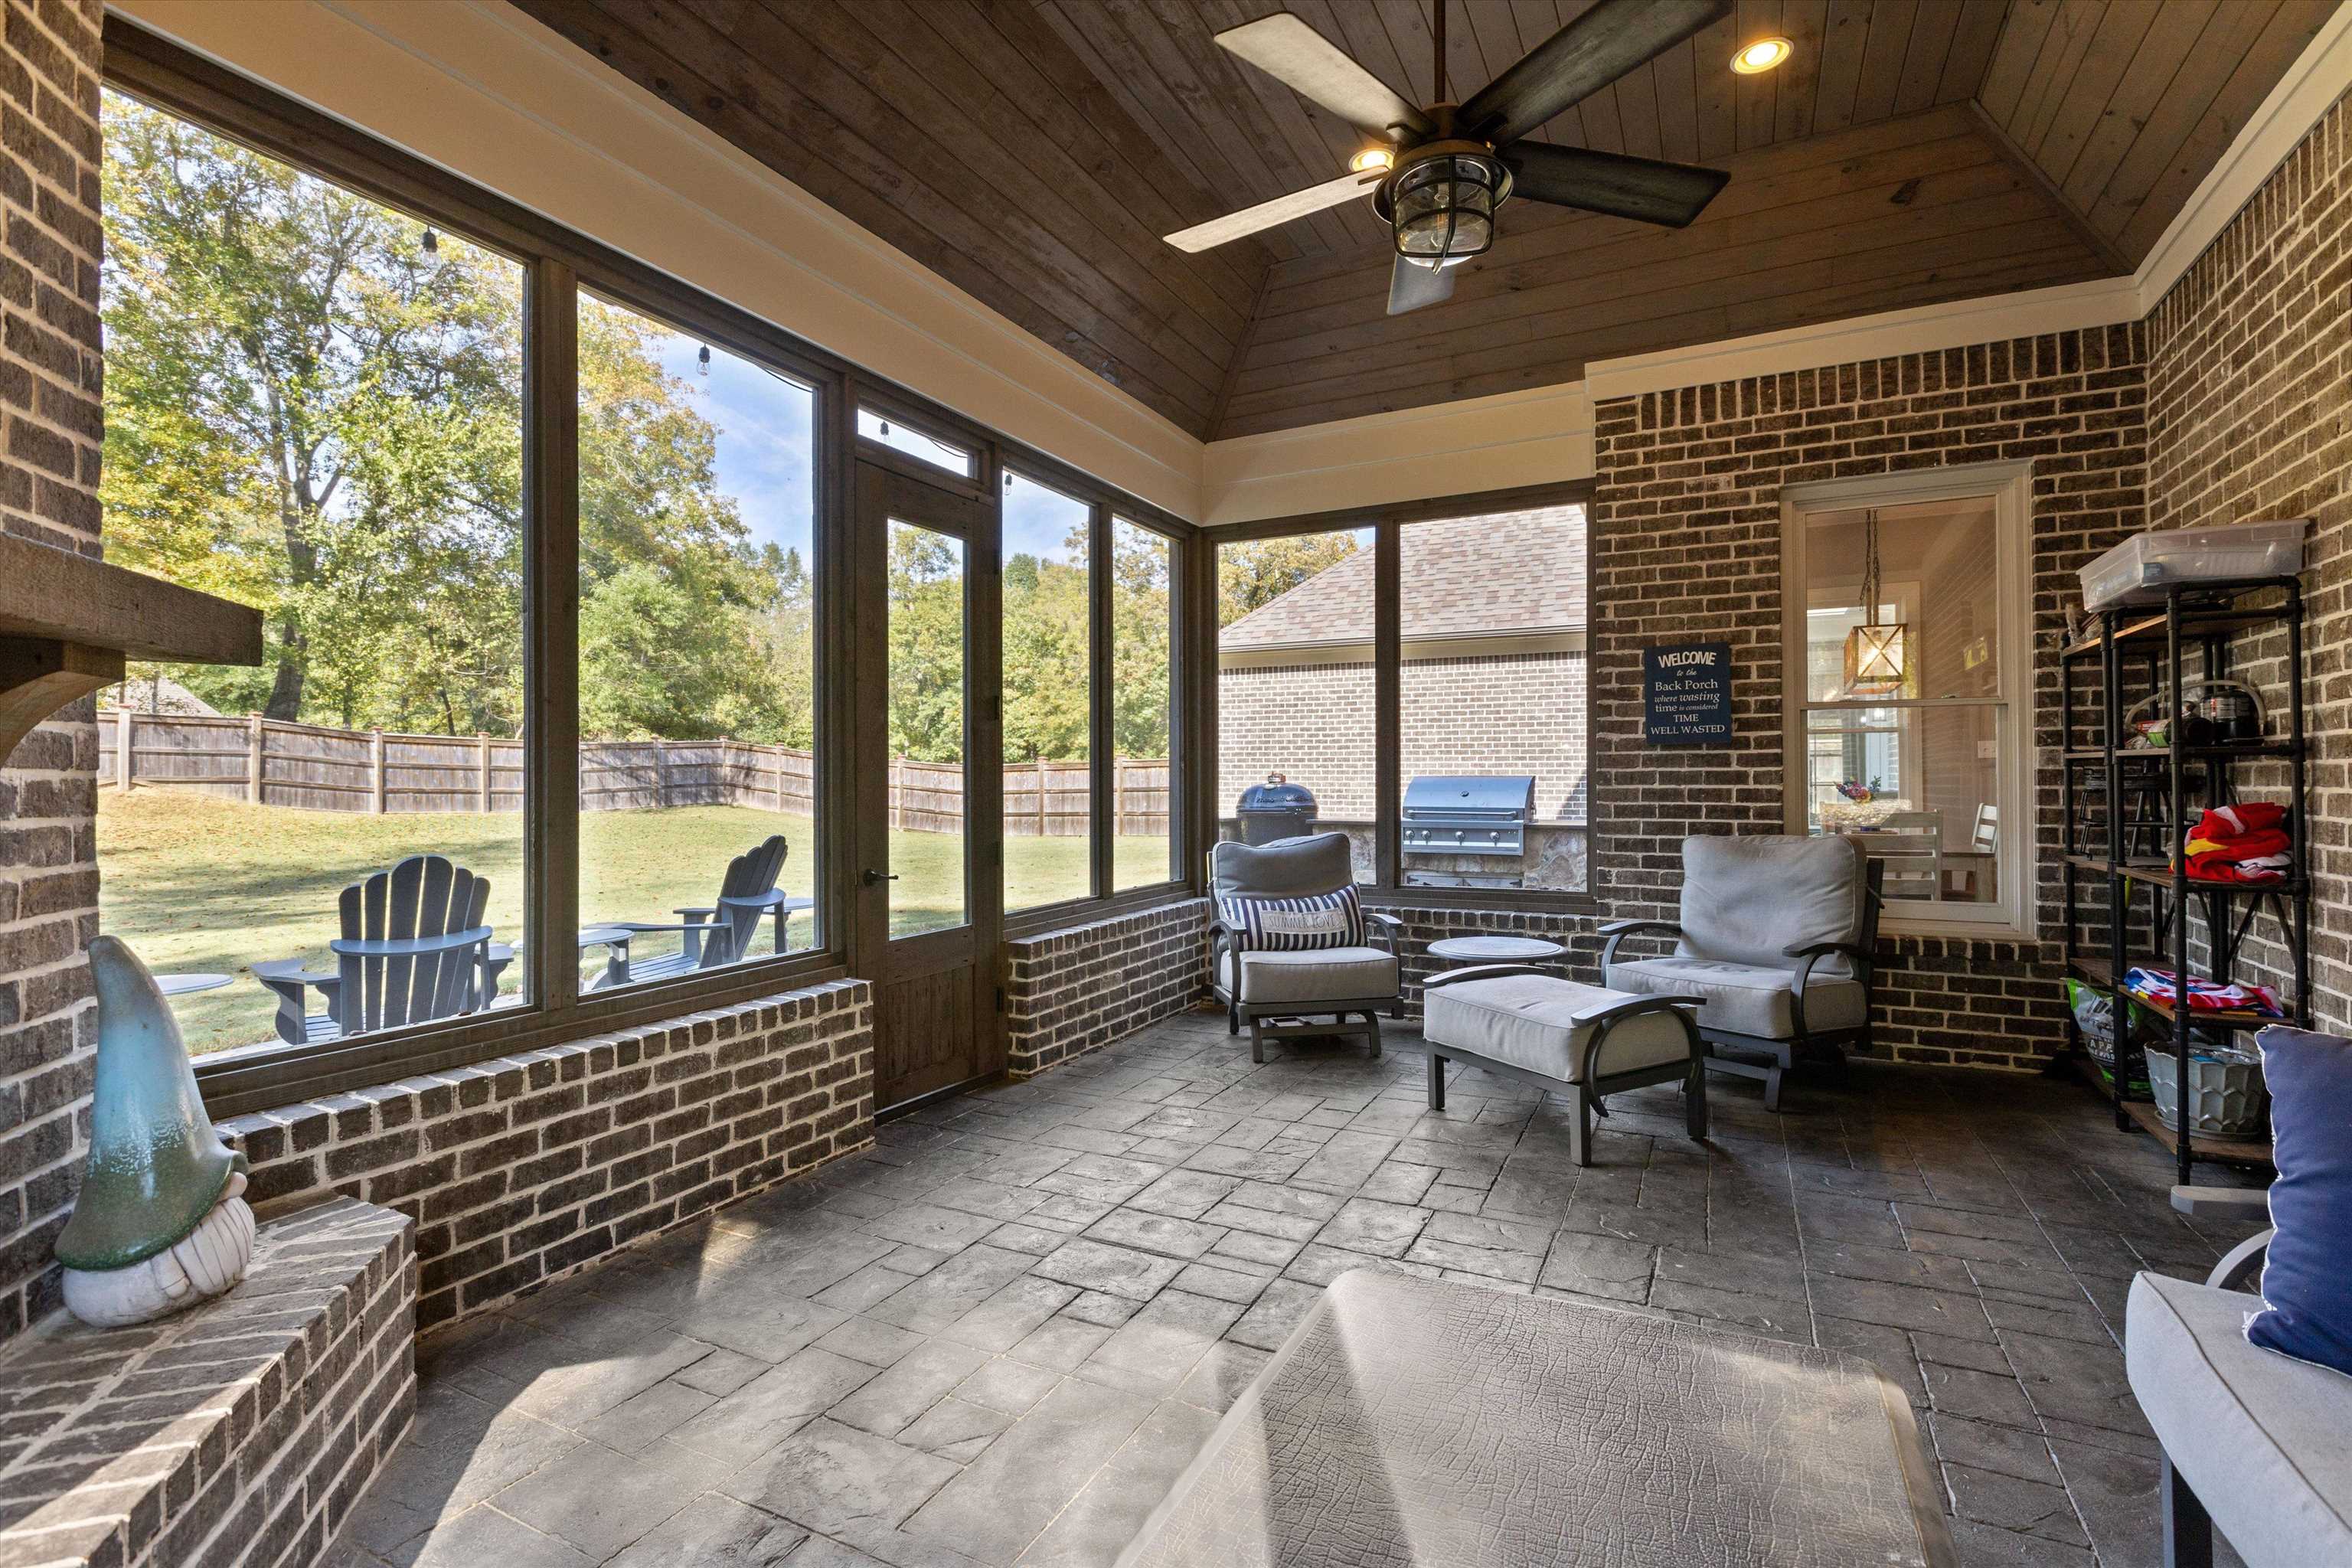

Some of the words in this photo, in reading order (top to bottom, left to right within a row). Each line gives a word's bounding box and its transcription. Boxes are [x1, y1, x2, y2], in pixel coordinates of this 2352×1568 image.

[1658, 651, 1717, 668] WELCOME
[1655, 680, 1682, 691] Back
[1684, 678, 1718, 690] Porch
[1654, 694, 1677, 703] where
[1679, 691, 1720, 703] wasting
[1655, 704, 1677, 712] time
[1685, 703, 1718, 711] considered
[1673, 714, 1700, 723] TIME
[1650, 726, 1679, 735] WELL
[1681, 724, 1725, 734] WASTED
[1269, 916, 1308, 929] SUMMER
